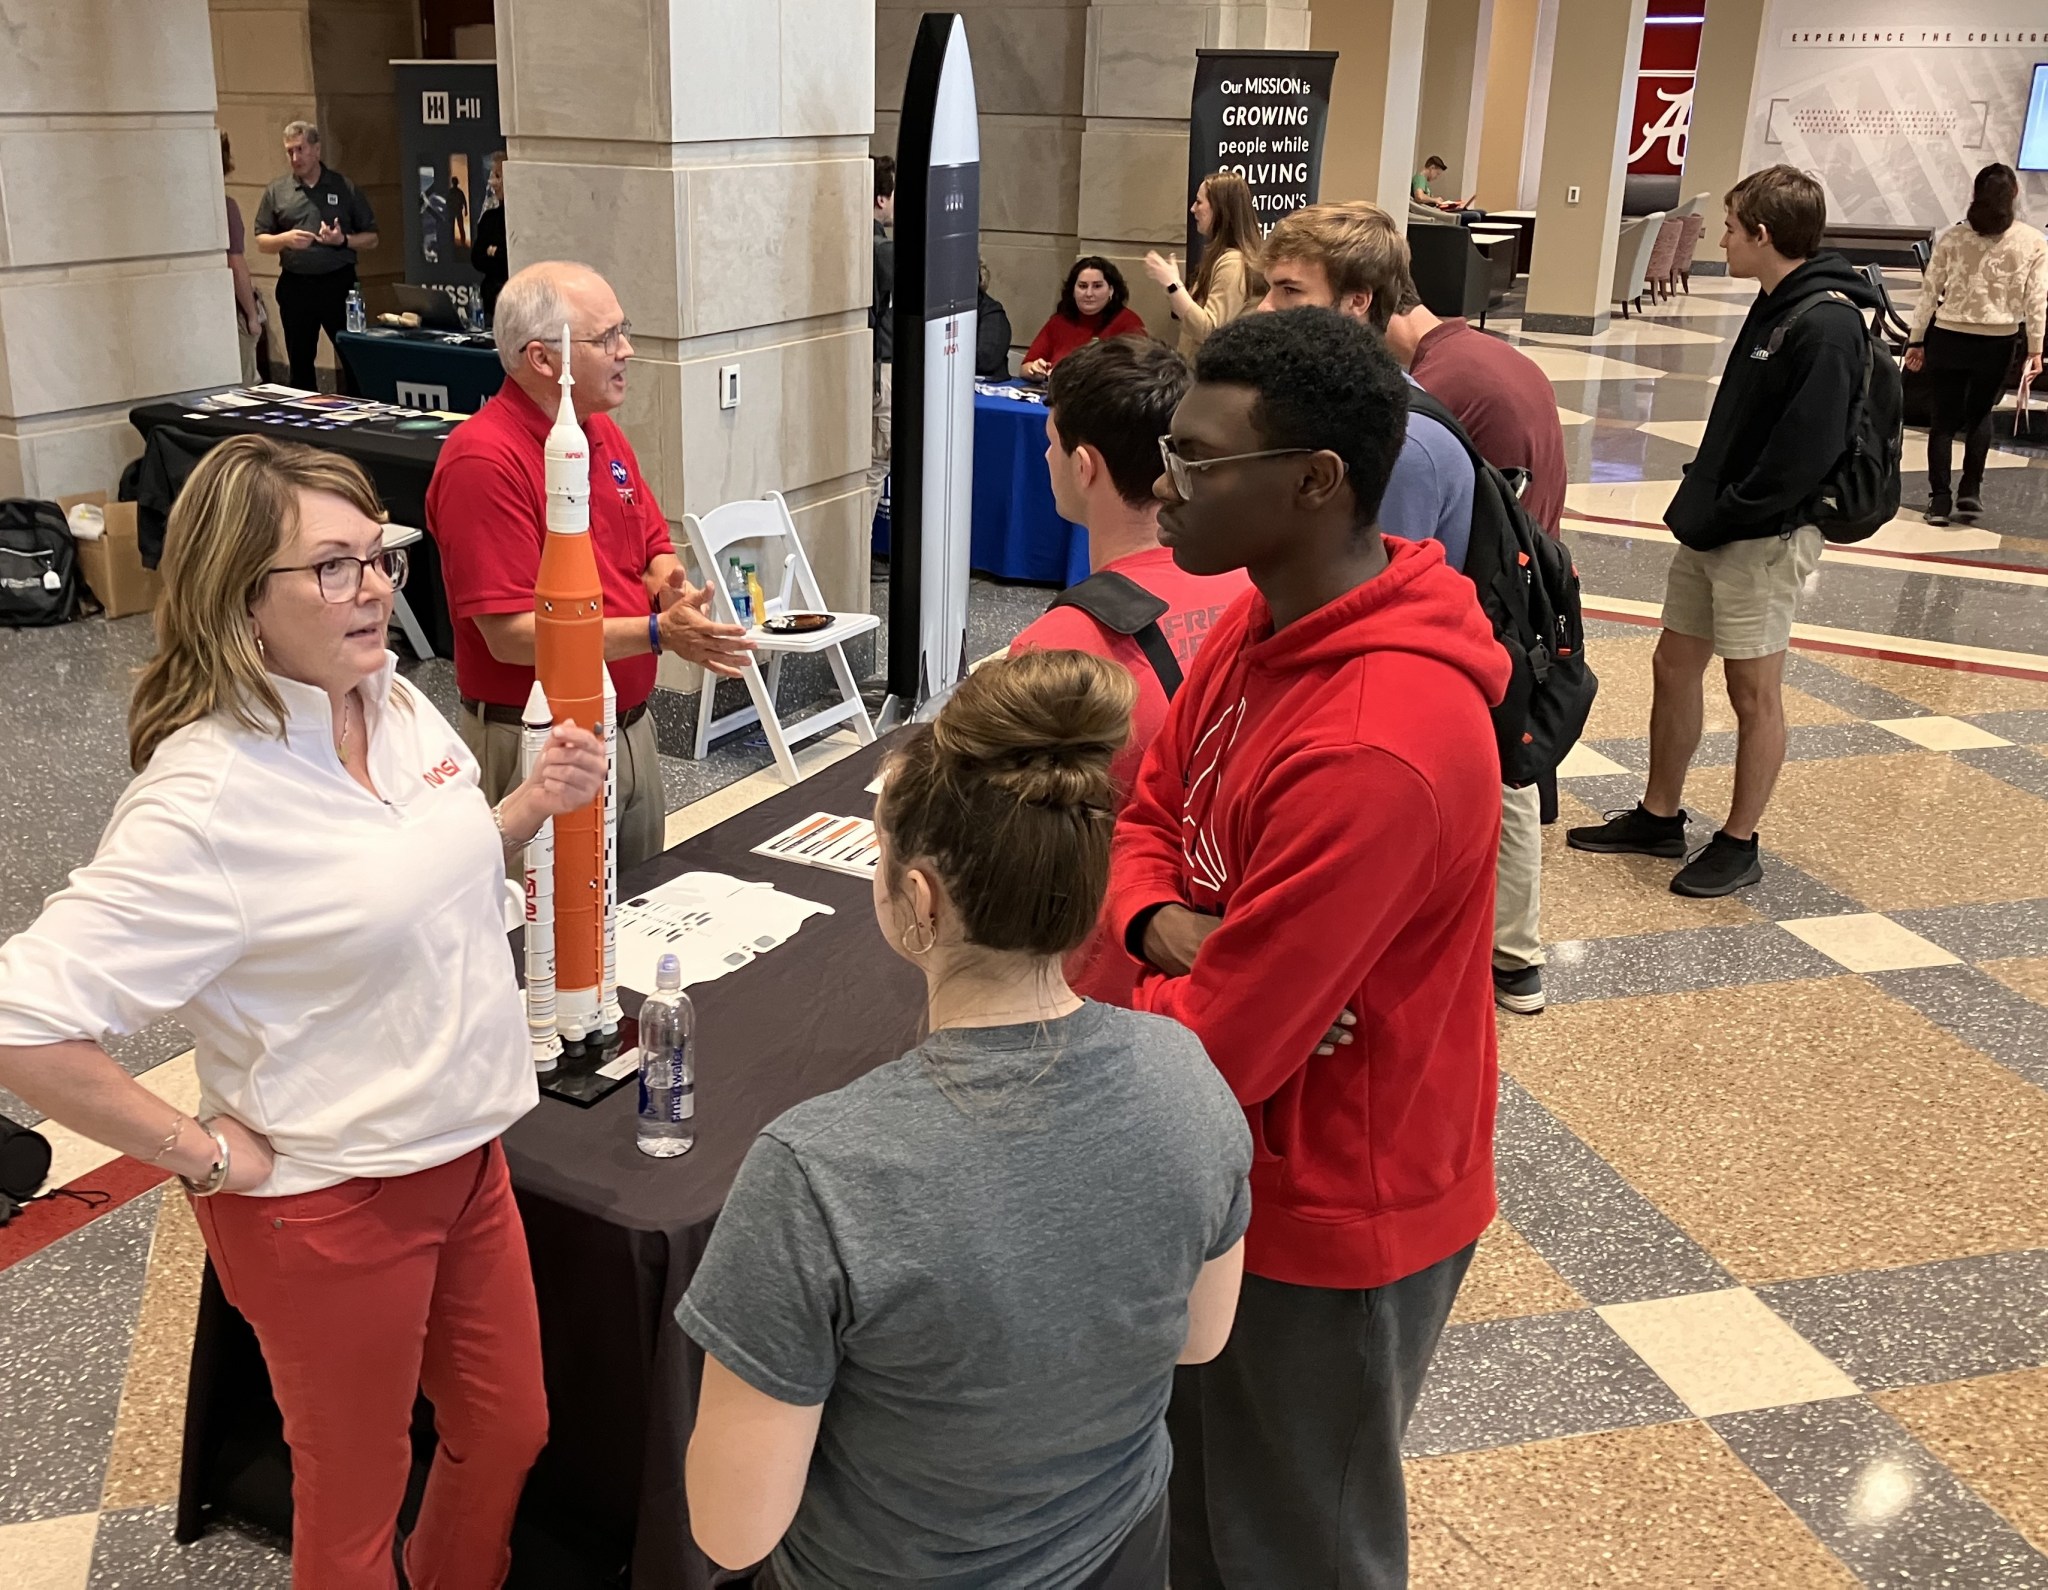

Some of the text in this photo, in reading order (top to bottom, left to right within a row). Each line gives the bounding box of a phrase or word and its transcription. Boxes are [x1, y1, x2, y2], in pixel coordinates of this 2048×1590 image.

[1791, 32, 2048, 42] EXPERIENCE THE COLLEGE
[1220, 78, 1311, 95] Our MISSION is
[456, 97, 480, 119] HII
[1222, 106, 1309, 126] GROWING
[1218, 136, 1310, 157] people while
